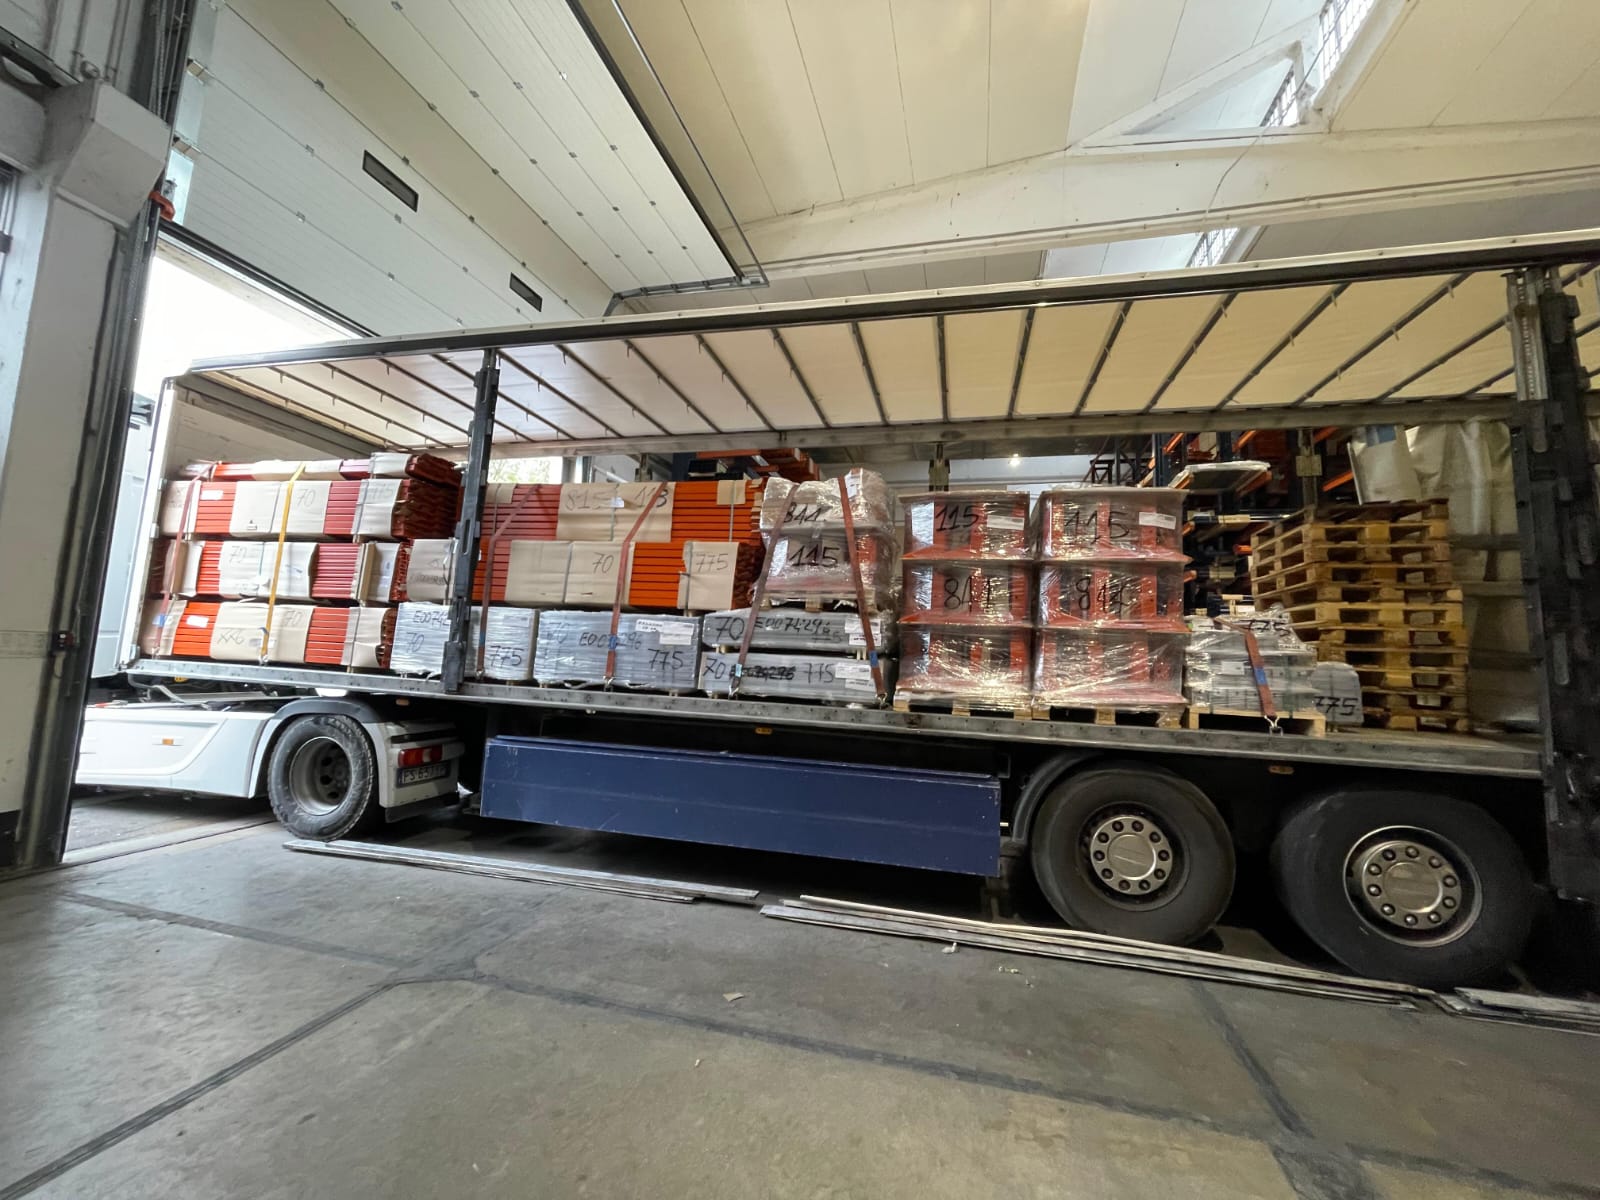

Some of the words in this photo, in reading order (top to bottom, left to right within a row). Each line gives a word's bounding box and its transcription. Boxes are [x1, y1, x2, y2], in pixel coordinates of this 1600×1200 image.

[935, 505, 980, 532] 115
[1064, 510, 1131, 545] 115
[592, 551, 615, 574] 70
[695, 553, 729, 574] 775
[788, 543, 840, 568] 115
[714, 615, 746, 641] 70
[405, 631, 425, 654] 70
[488, 645, 525, 668] 775
[647, 648, 685, 670] 775
[703, 657, 726, 680] 70
[801, 662, 836, 684] 775
